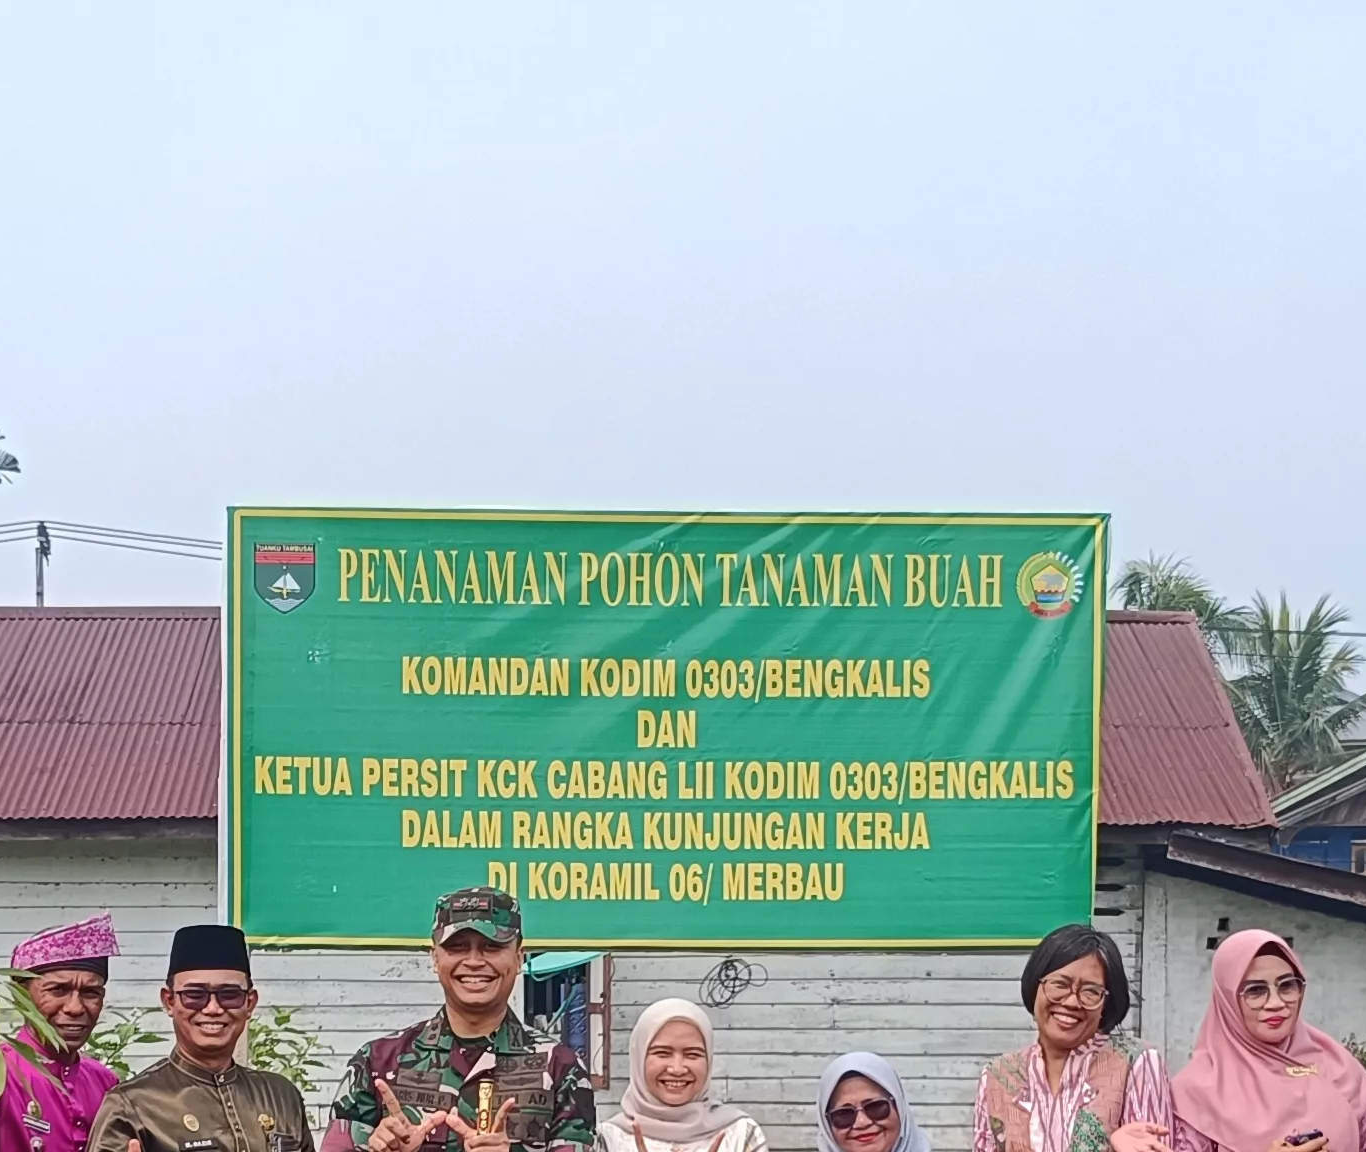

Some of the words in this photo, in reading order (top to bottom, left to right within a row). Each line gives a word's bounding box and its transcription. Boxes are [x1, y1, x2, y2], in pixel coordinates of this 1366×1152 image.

[337, 548, 568, 606] PENANAMAN
[579, 552, 704, 607] POHON
[716, 554, 895, 607] TANAMAN
[903, 554, 1004, 608] BUAH
[402, 656, 569, 697] KOMANDAN
[580, 658, 676, 697] KODIM
[685, 659, 931, 702] 0303/BENGKALIS
[636, 710, 696, 749] DAN
[254, 756, 352, 796] KETUA
[362, 757, 468, 797] PERSIT
[477, 759, 537, 798] KCK
[547, 760, 667, 799] CABANG
[678, 762, 715, 799] LII
[725, 761, 820, 799] KODIM
[829, 761, 1074, 802] 0303/BENGKALIS
[401, 809, 502, 849] DALAM
[512, 811, 633, 849] RANGKA
[643, 812, 826, 850] KUNJUNGAN
[835, 812, 930, 850] KERJA
[487, 861, 518, 900] DI
[528, 862, 661, 900] KORAMIL
[668, 863, 714, 906] 06/
[721, 863, 845, 900] MERBAU
[528, 1090, 548, 1106] AD
